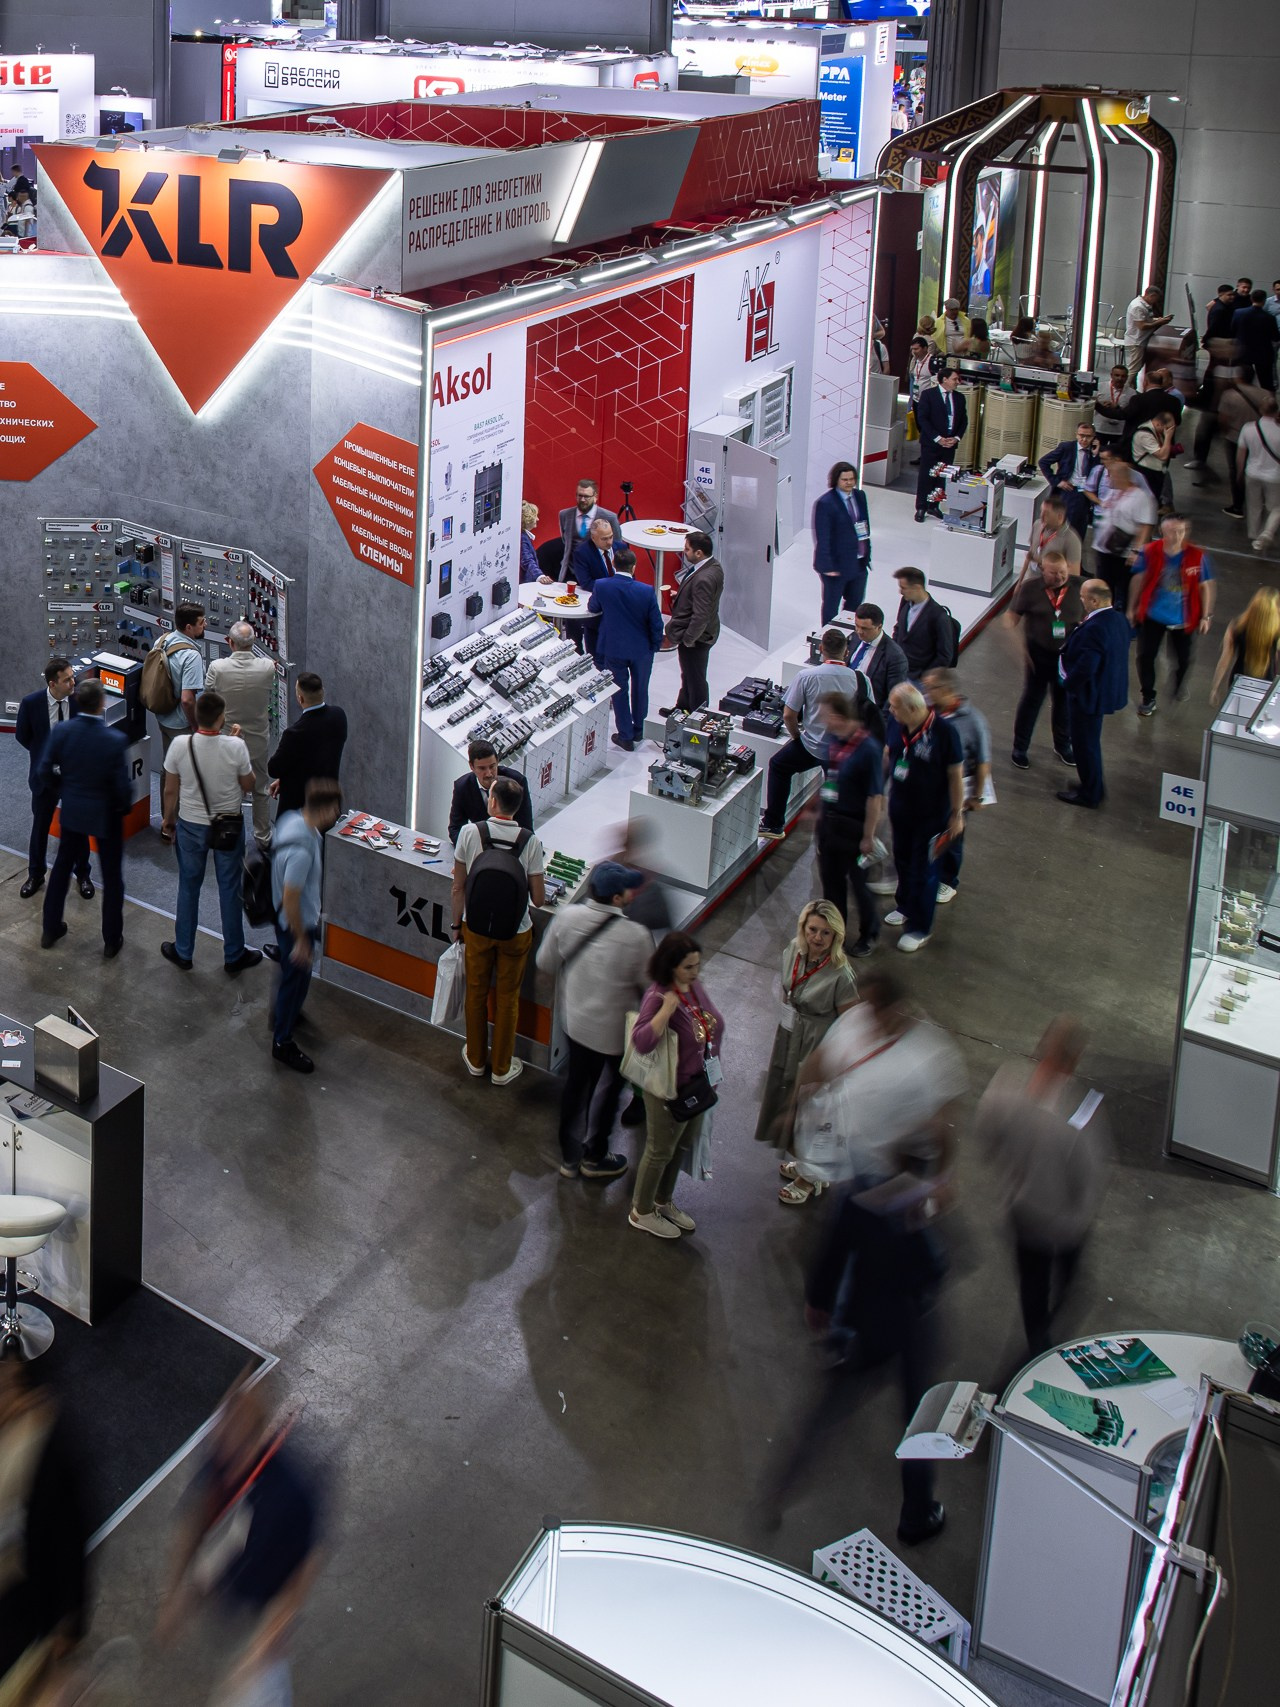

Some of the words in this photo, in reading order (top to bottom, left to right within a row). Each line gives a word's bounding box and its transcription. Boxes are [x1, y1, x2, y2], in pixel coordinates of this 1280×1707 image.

[282, 67, 340, 79] СДЕЛАНО
[409, 189, 458, 220] РЕШЕНИЕ
[461, 185, 481, 213] ДЛЯ
[485, 173, 542, 204] ЭНЕРГЕТИКИ
[83, 159, 304, 279] KLR
[408, 213, 493, 253] РАСПРЕДЕЛЕНИЕ
[496, 212, 502, 232] И
[505, 201, 551, 230] КОНТРОЛЬ
[432, 352, 492, 407] Aksol
[333, 456, 367, 476] КОНЦЕВЫЕ
[367, 470, 415, 498] ВЫКЛЮЧАТЕЛИ
[344, 440, 398, 469] ПРОМЫШЛЕННЫЕ
[398, 464, 415, 477] РЕЛЕ
[699, 466, 711, 474] 4E
[332, 475, 369, 498] КАБЕЛЬНЫЕ
[369, 492, 414, 519] НАКОНЕЧНИКИ
[696, 476, 713, 485] 020
[336, 496, 373, 519] КАБЕЛЬНЫЙ
[373, 513, 413, 539] ИНСТРУМЕНТ
[351, 523, 389, 549] КАБЕЛЬНЫЕ
[389, 541, 412, 560] ВВОДЫ
[360, 543, 403, 575] КЛЕММЫ
[105, 677, 119, 688] KLR
[1165, 801, 1196, 817] 001
[1171, 785, 1194, 799] 4E
[389, 885, 452, 944] KL
